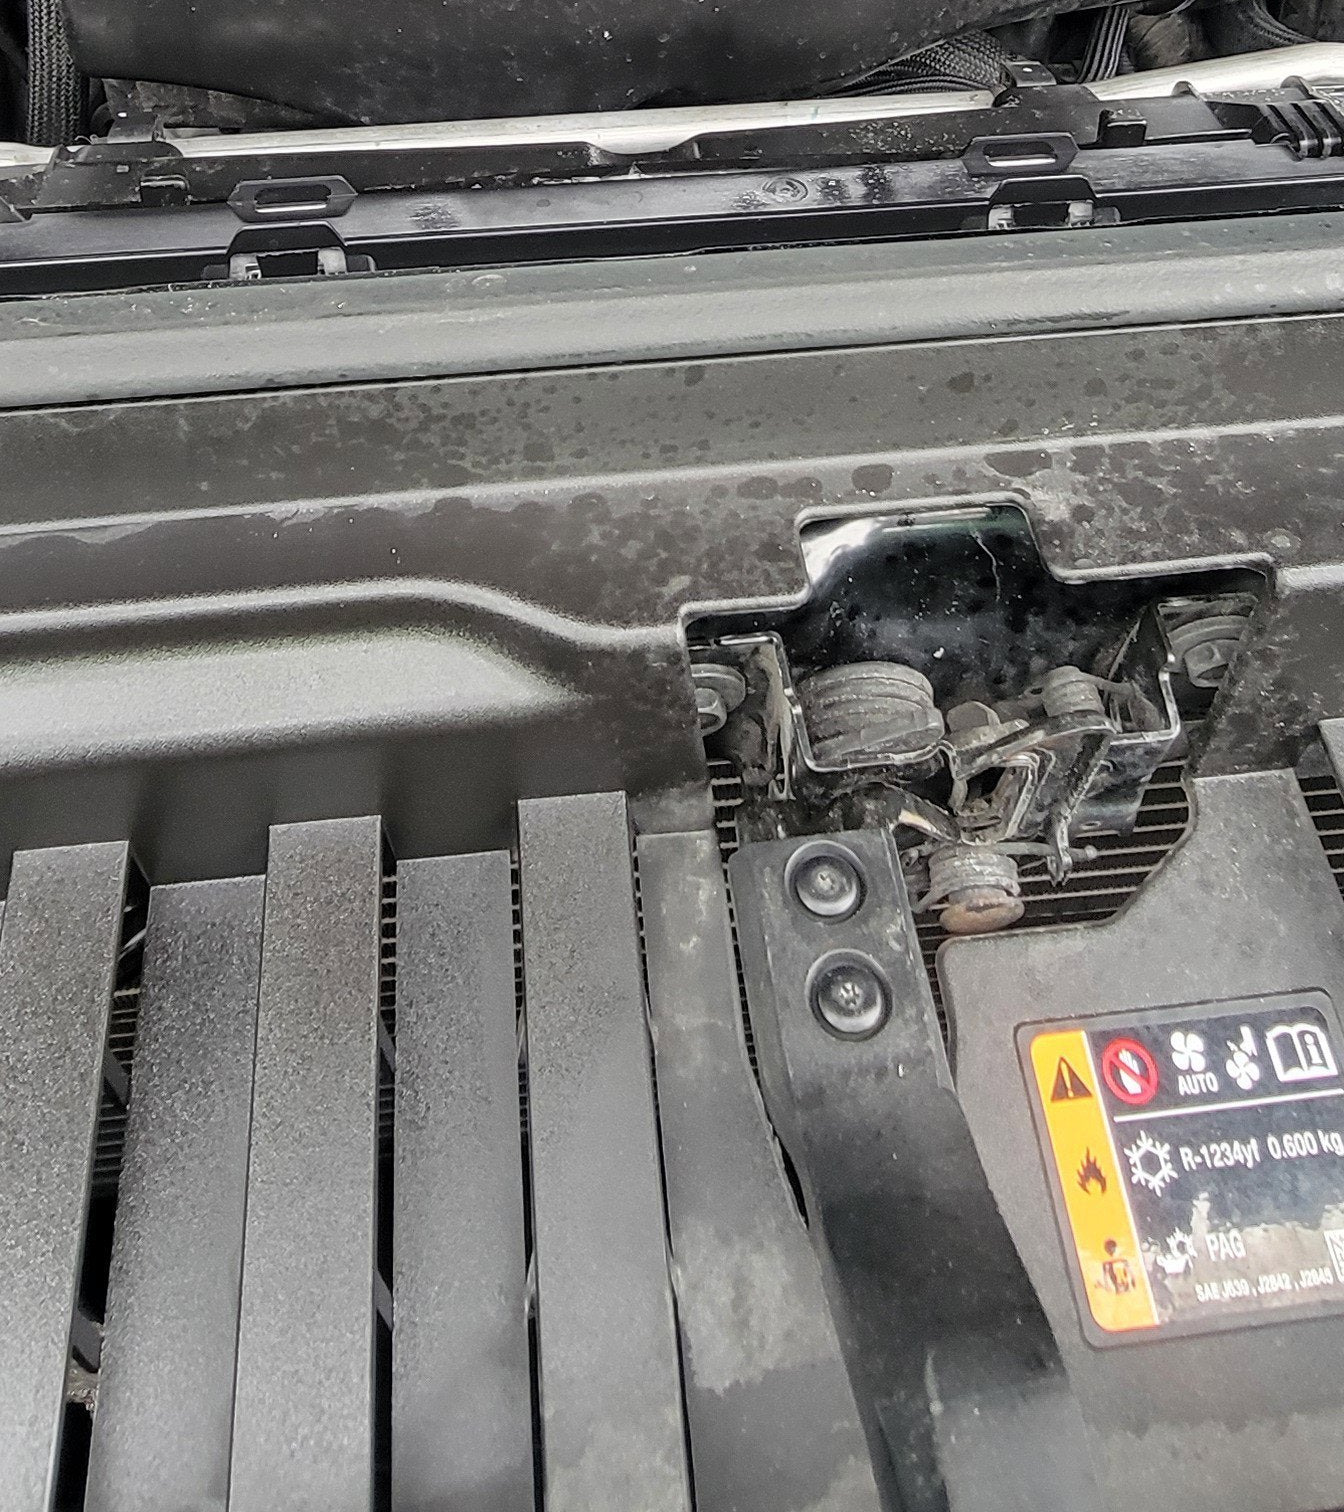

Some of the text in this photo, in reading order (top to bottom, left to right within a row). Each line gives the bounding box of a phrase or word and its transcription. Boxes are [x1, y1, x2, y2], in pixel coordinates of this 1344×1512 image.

[1178, 1072, 1219, 1096] AUTO
[1179, 1138, 1261, 1172] R-1234yf
[1267, 1131, 1318, 1160] 0.600
[1205, 1228, 1247, 1262] PAG
[1195, 1282, 1220, 1303] SAE
